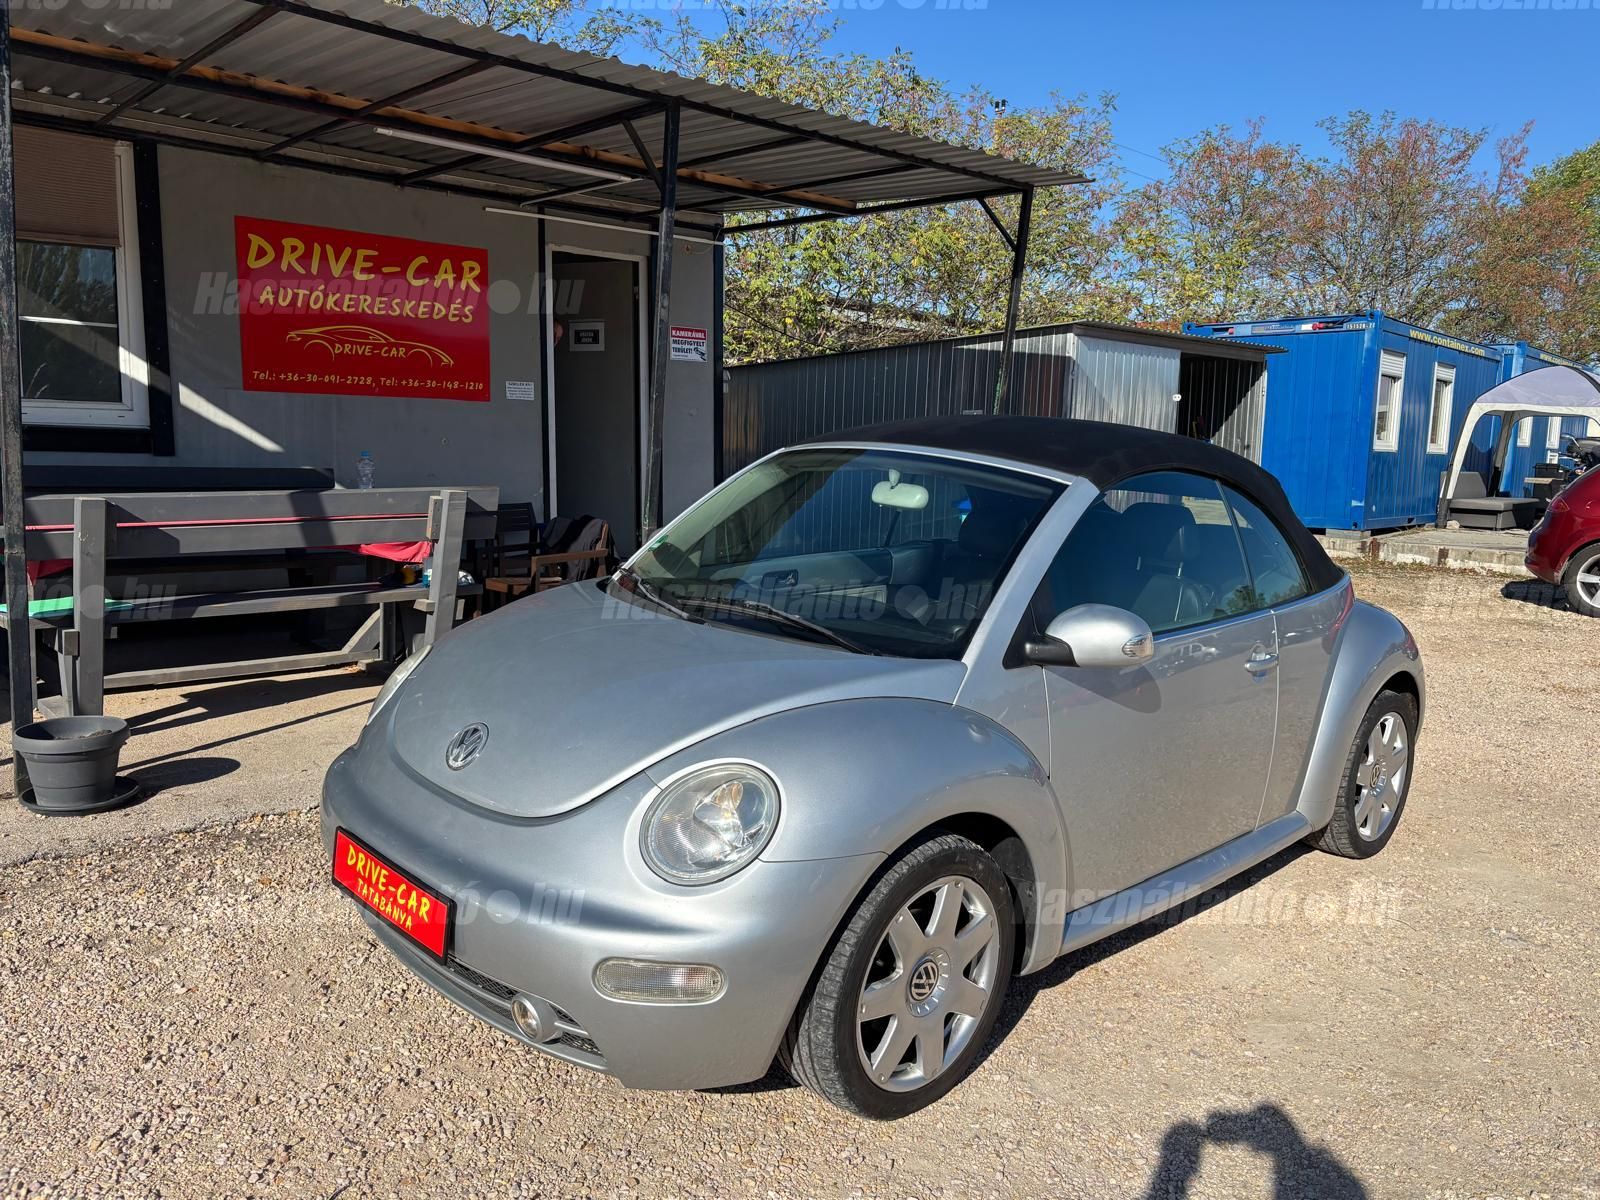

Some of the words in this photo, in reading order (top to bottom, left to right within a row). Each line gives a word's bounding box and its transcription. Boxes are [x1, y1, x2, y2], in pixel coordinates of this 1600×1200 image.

[247, 233, 481, 293] DRIVE-CAR
[259, 285, 473, 323] AUTÓKERESKEDÉS
[672, 330, 706, 339] KAMERÁVAL
[672, 339, 705, 347] MEGFIGYELT
[1409, 329, 1486, 356] www.containex.com
[334, 343, 406, 358] DRIVE-CAR
[252, 370, 275, 380] Tel.:
[347, 844, 431, 923] DRIVE-CAR
[357, 878, 413, 931] TATABÁNYA
